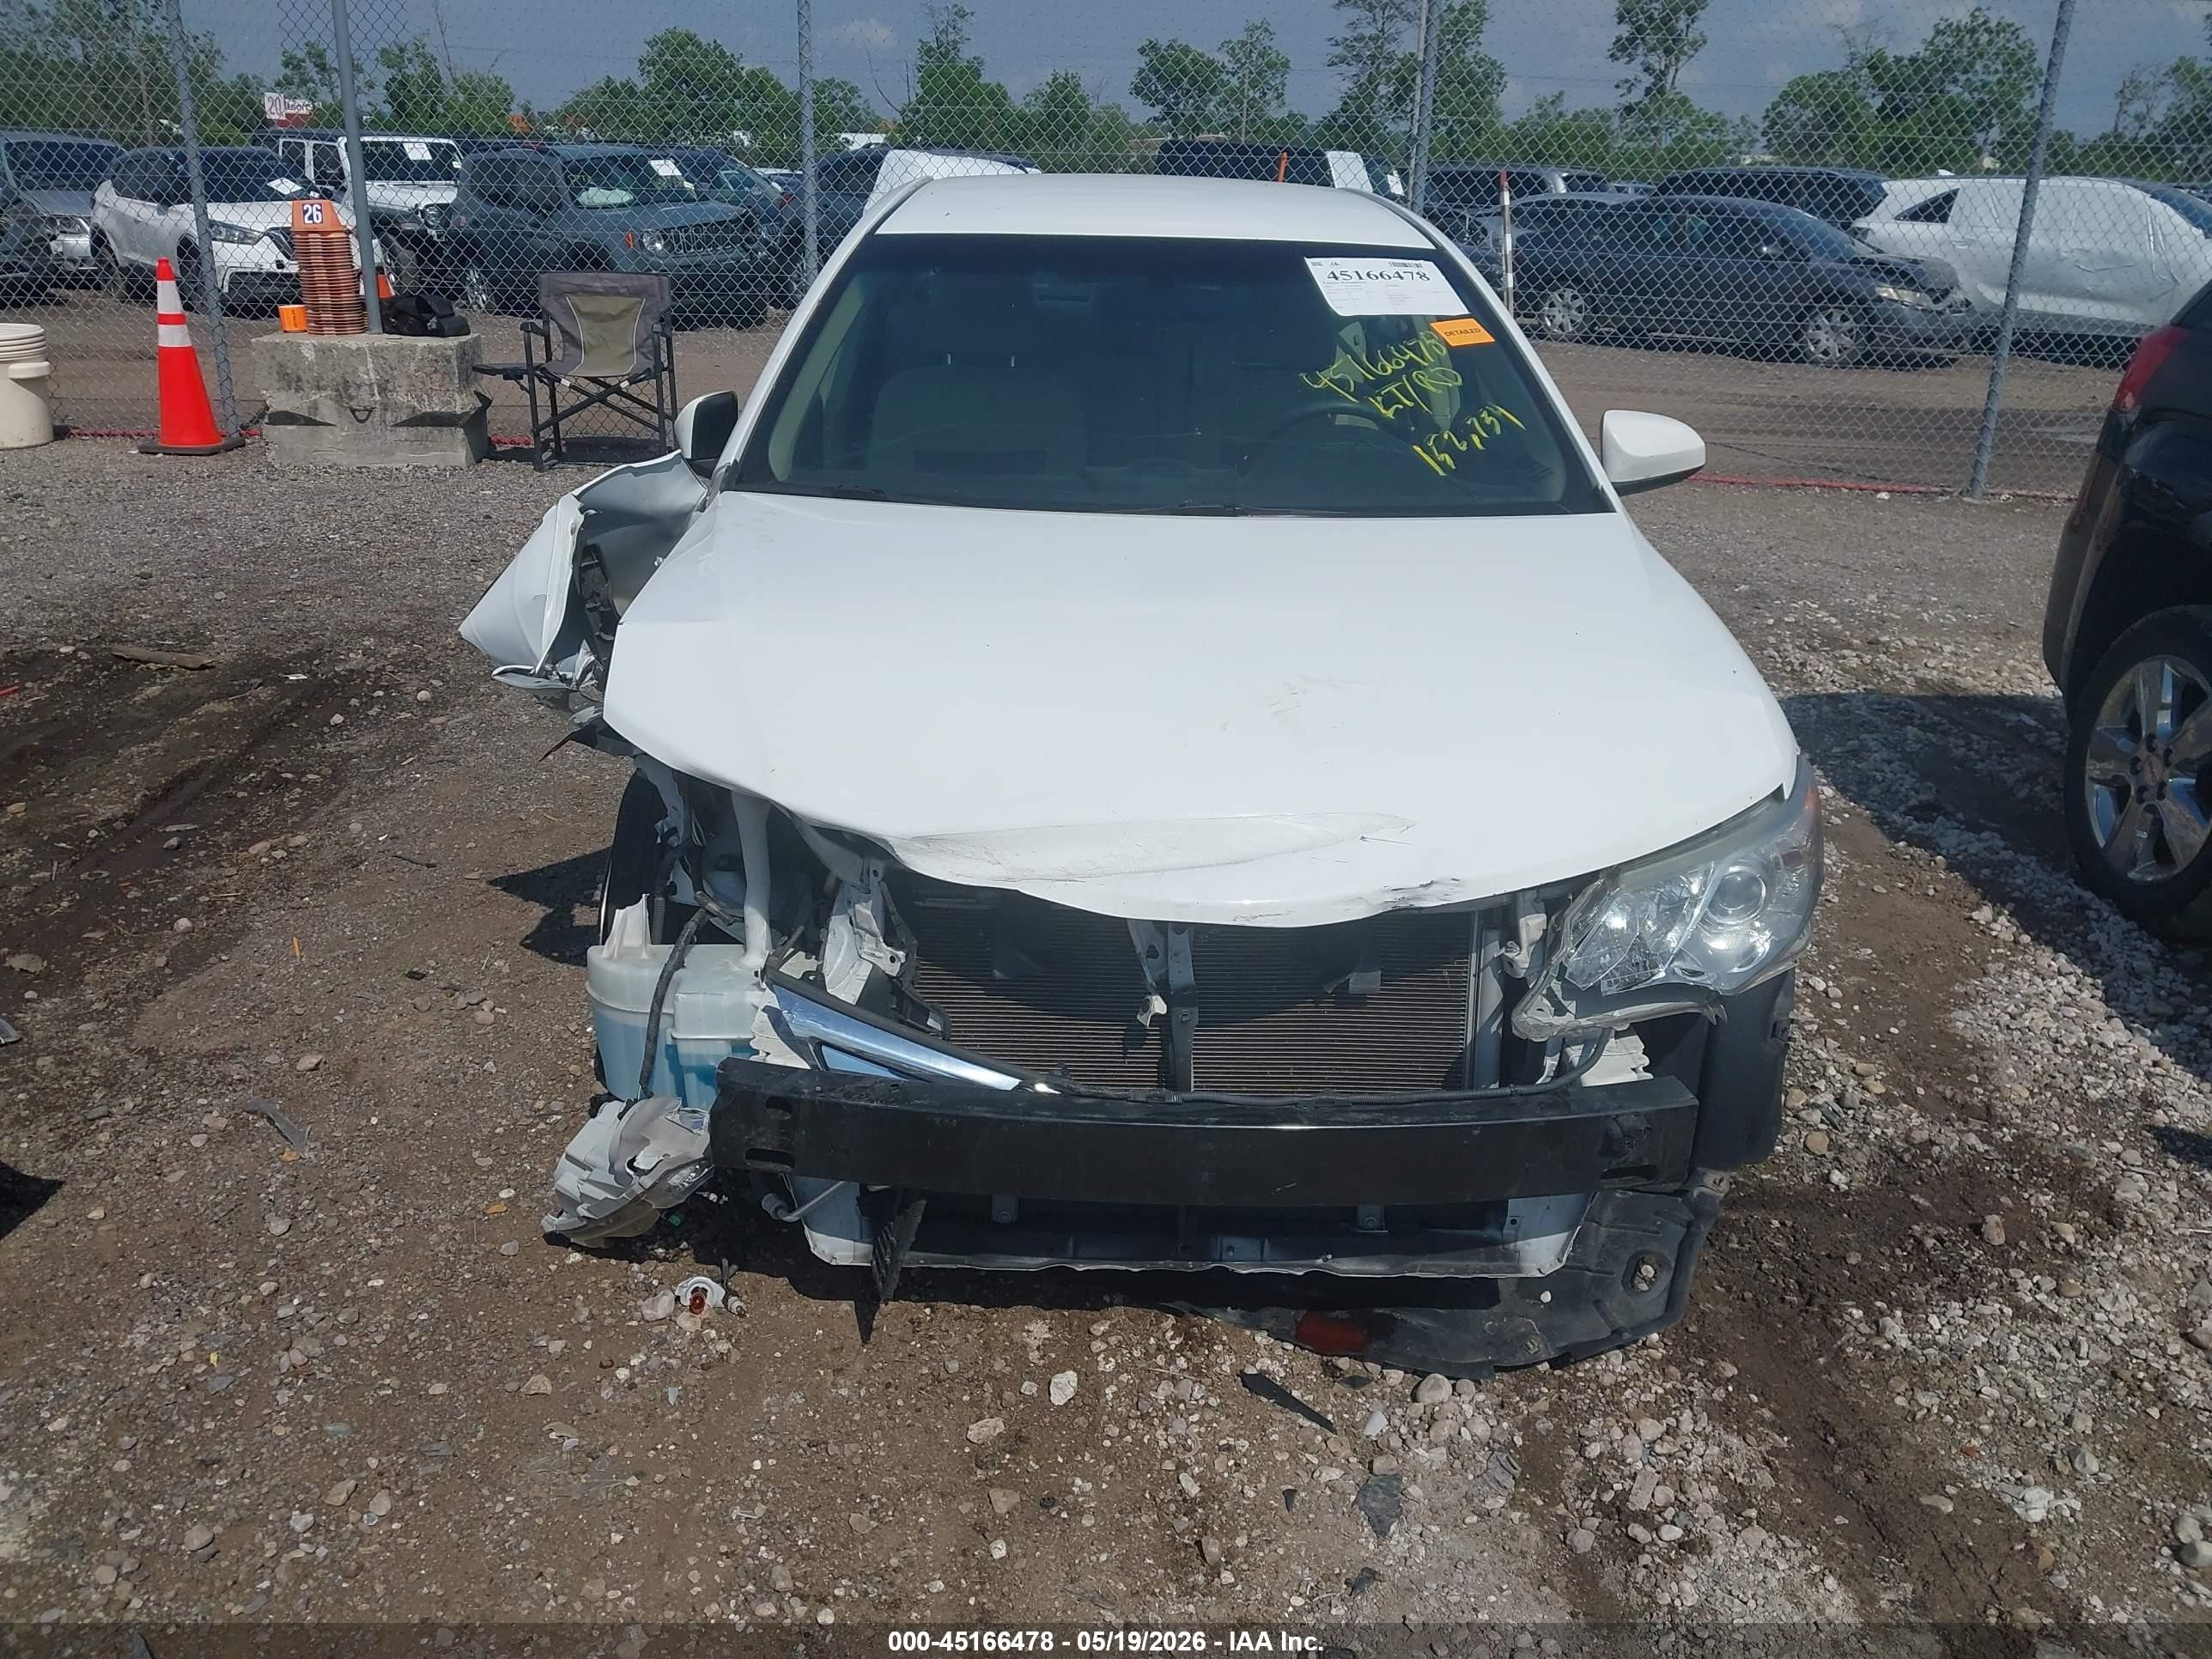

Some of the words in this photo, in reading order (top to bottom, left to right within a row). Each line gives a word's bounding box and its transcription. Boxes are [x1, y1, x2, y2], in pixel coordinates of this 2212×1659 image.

[303, 204, 322, 223] 26
[1326, 270, 1431, 283] 45166478
[1443, 327, 1481, 337] DETAILED
[1299, 330, 1448, 404] 45166478
